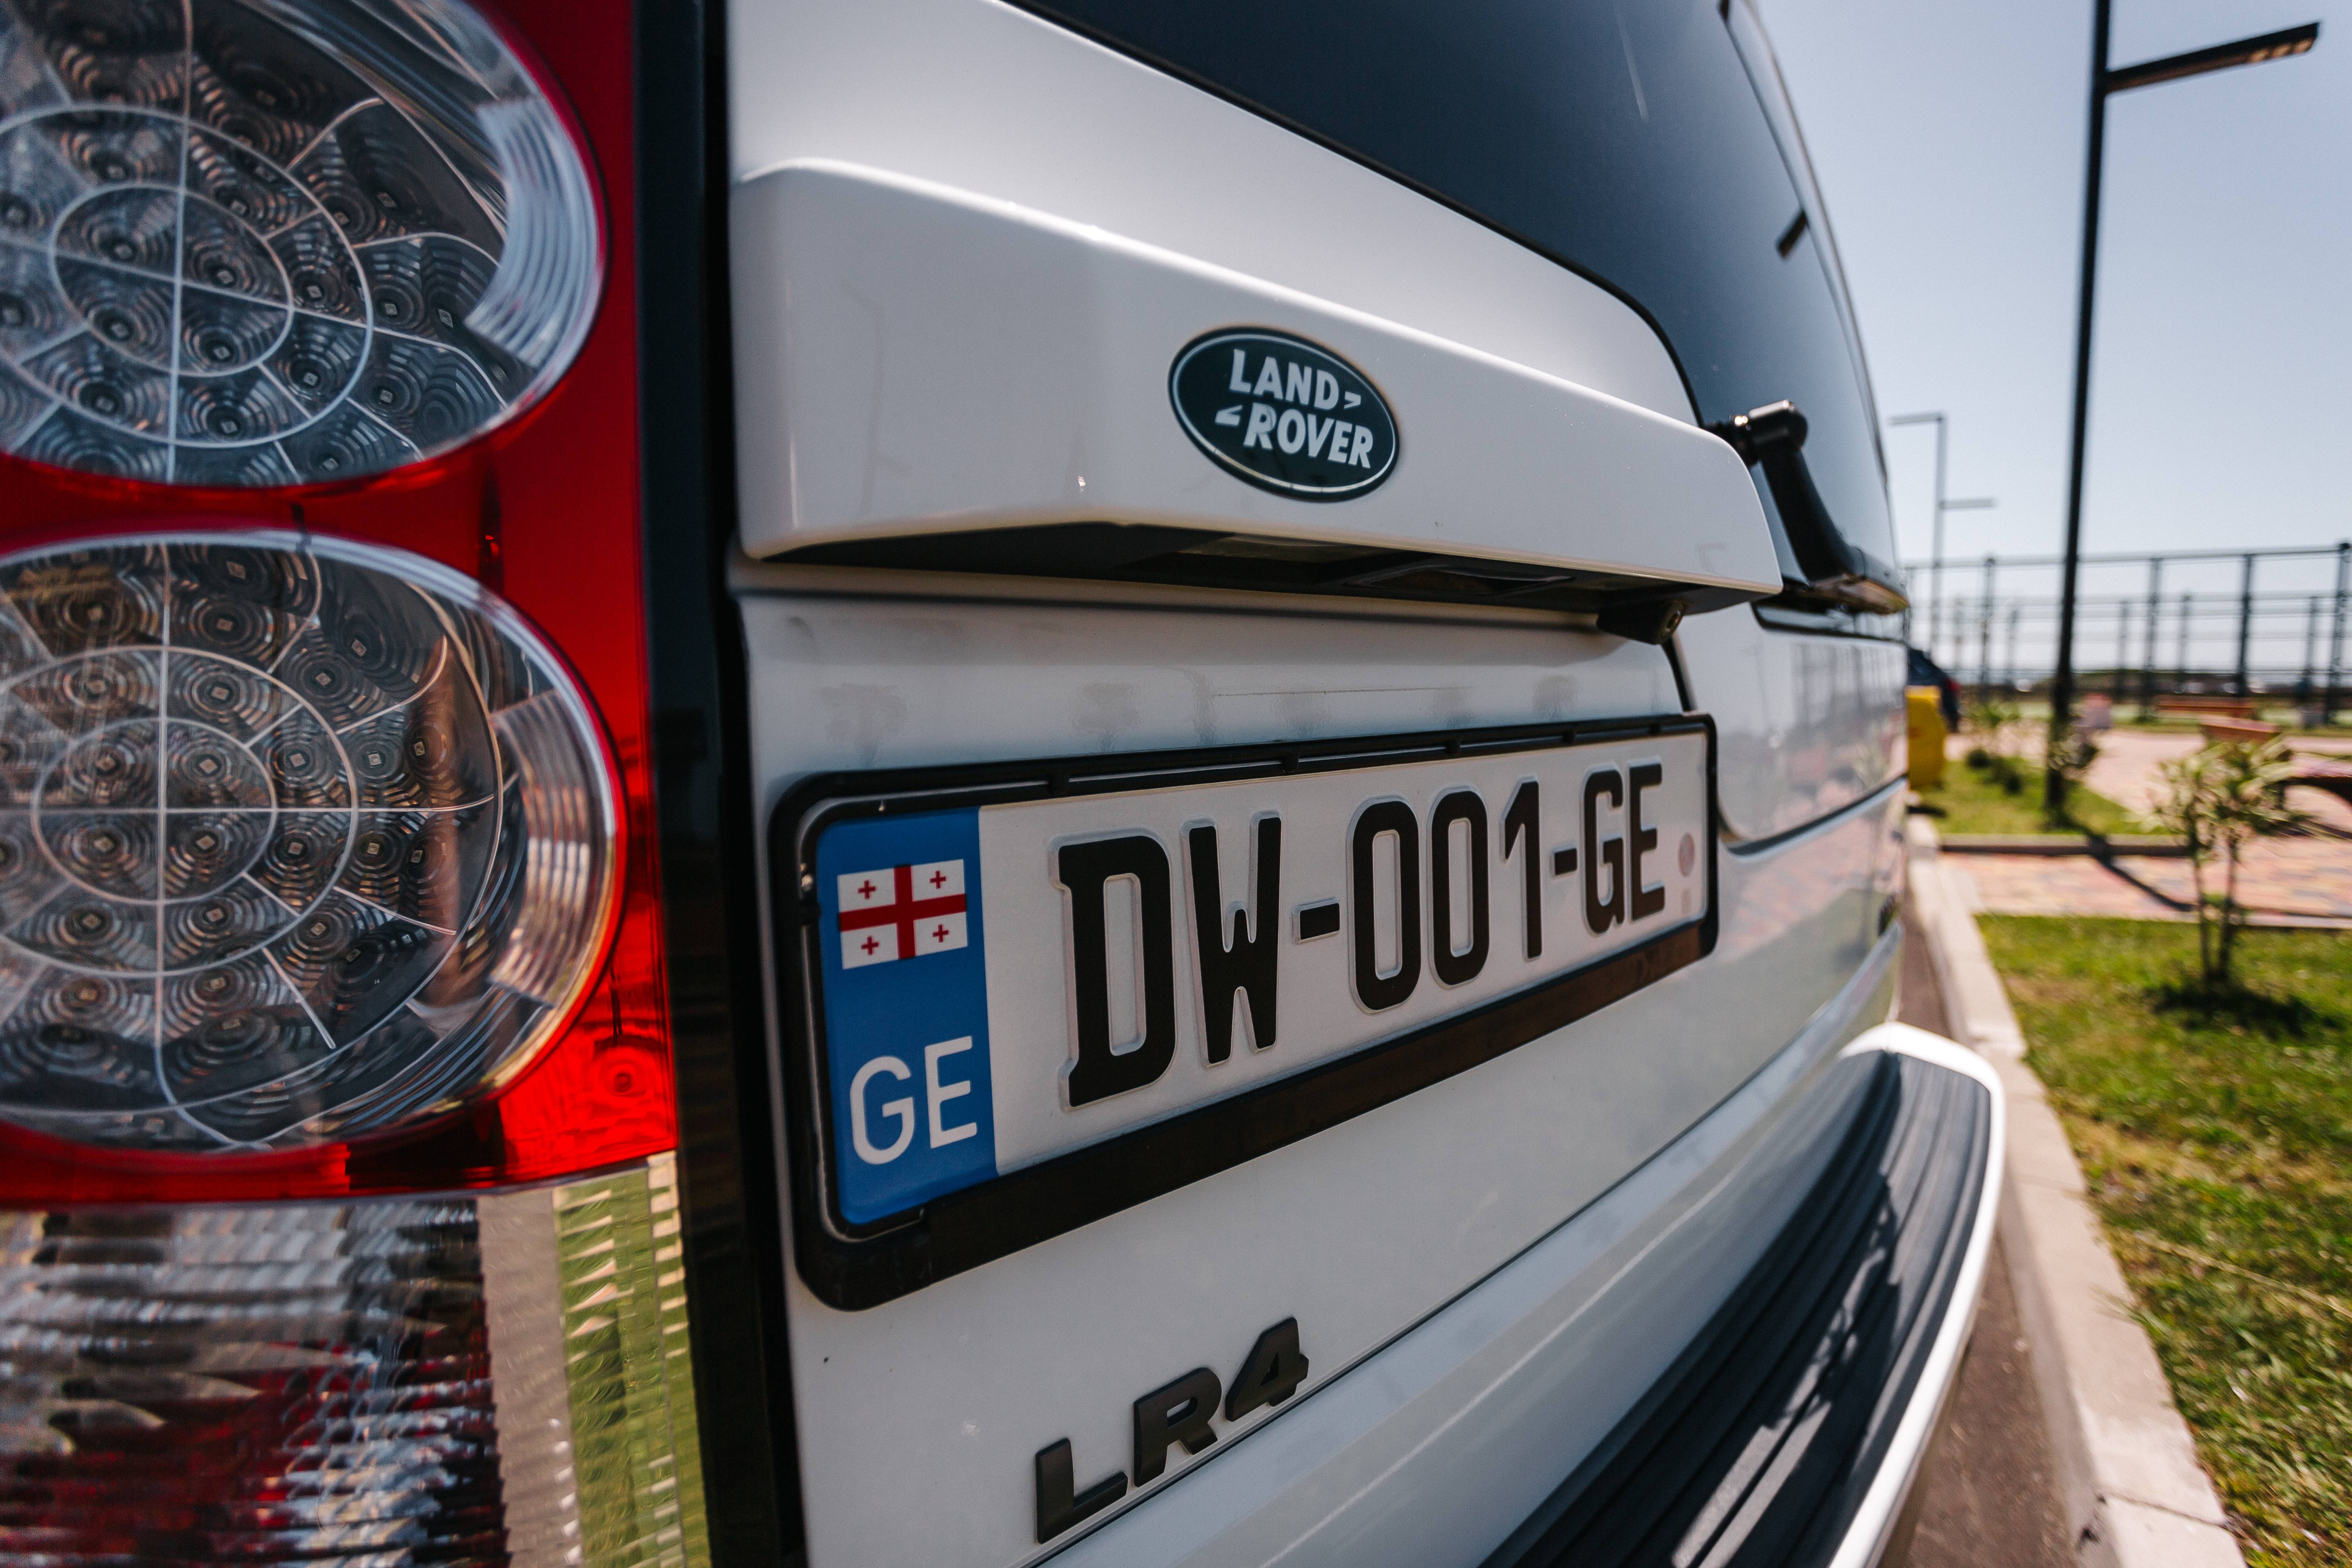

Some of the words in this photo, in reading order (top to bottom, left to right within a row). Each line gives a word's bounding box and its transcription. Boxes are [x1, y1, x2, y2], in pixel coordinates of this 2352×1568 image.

[1229, 349, 1339, 410] LAND
[1243, 402, 1374, 468] ROVER
[1058, 763, 1666, 1108] DW-001-GE
[849, 1035, 978, 1165] GE
[1035, 1316, 1309, 1545] LR4
